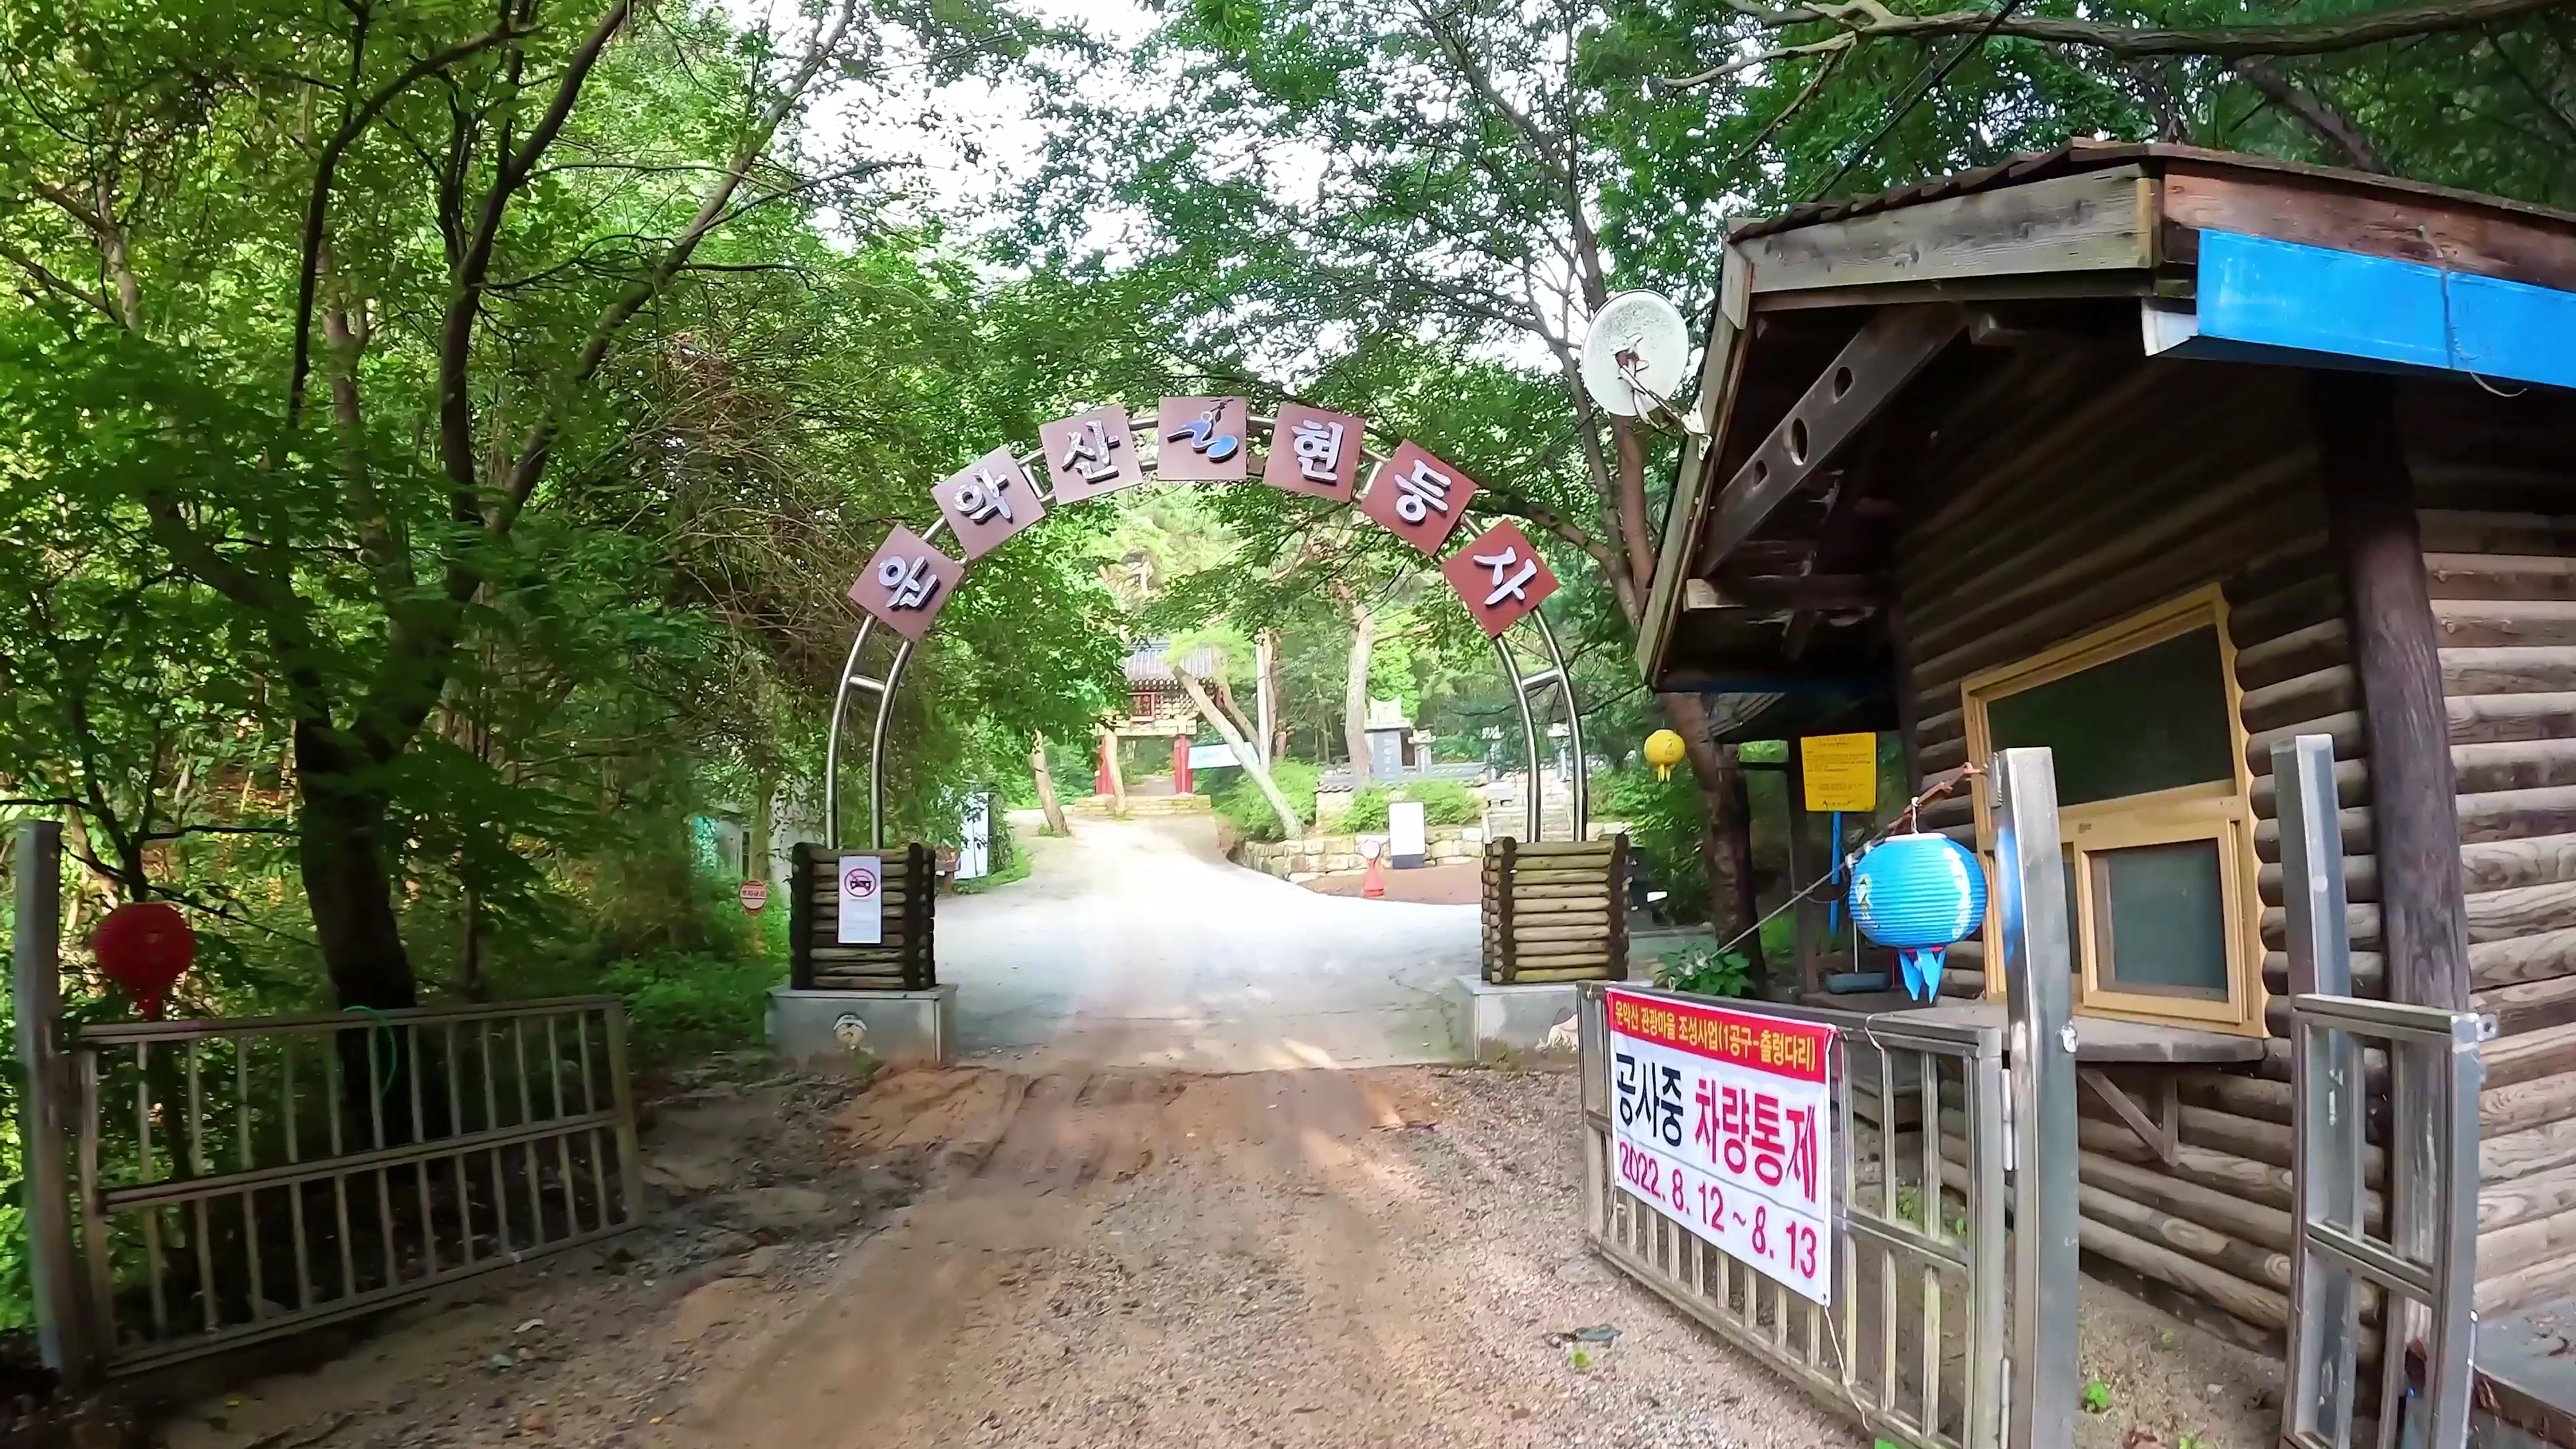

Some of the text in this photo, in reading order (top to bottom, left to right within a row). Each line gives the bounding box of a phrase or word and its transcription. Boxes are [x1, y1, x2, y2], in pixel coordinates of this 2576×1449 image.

[877, 419, 1538, 608] 운악산 현등사
[1615, 1000, 1639, 1032] 운악산
[1641, 1007, 1676, 1040] 관광마을
[1615, 1053, 1817, 1204] 공사중 차량통제
[1619, 1141, 1666, 1203] 2022.
[1672, 1168, 1690, 1216] 8.
[1786, 1220, 1817, 1279] 13
